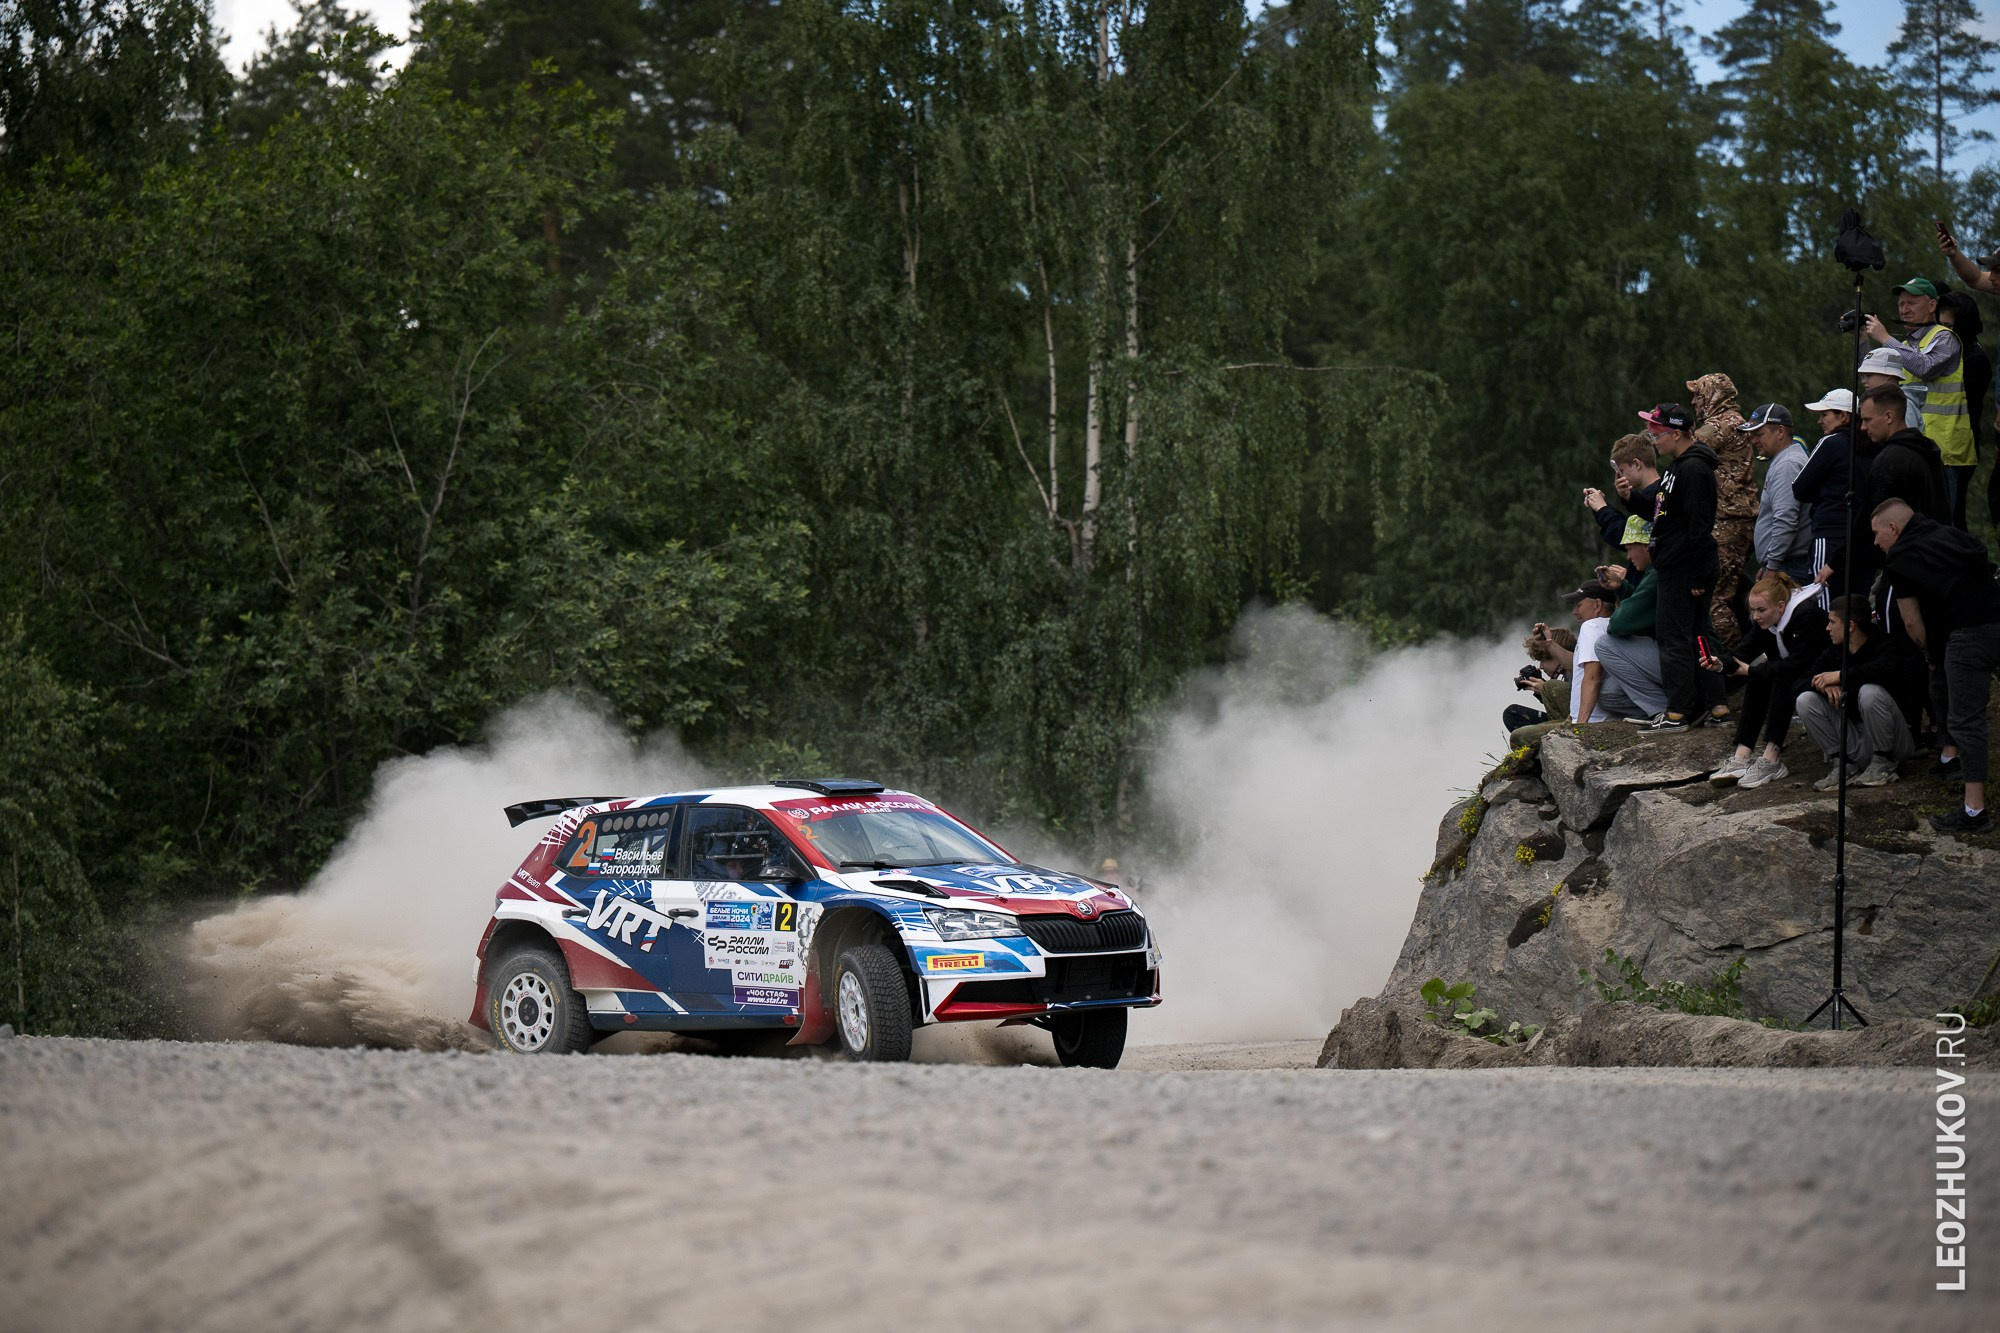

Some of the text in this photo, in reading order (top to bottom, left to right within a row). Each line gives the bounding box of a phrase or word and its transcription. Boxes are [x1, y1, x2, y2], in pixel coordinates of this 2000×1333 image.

[809, 801, 926, 815] РАЛЛИ РОССИИ
[571, 821, 597, 867] 2
[614, 848, 664, 861] Васильев
[600, 862, 661, 877] Загороднюк
[586, 889, 675, 953] VRT
[730, 915, 750, 923] 2024
[780, 903, 793, 931] 2
[729, 935, 765, 945] РАЛЛИ
[727, 945, 770, 955] РОССИИ
[932, 955, 979, 969] PIRELLI
[737, 971, 794, 984] СИТИДРАЙВ
[747, 996, 789, 1005] www.staf.ru
